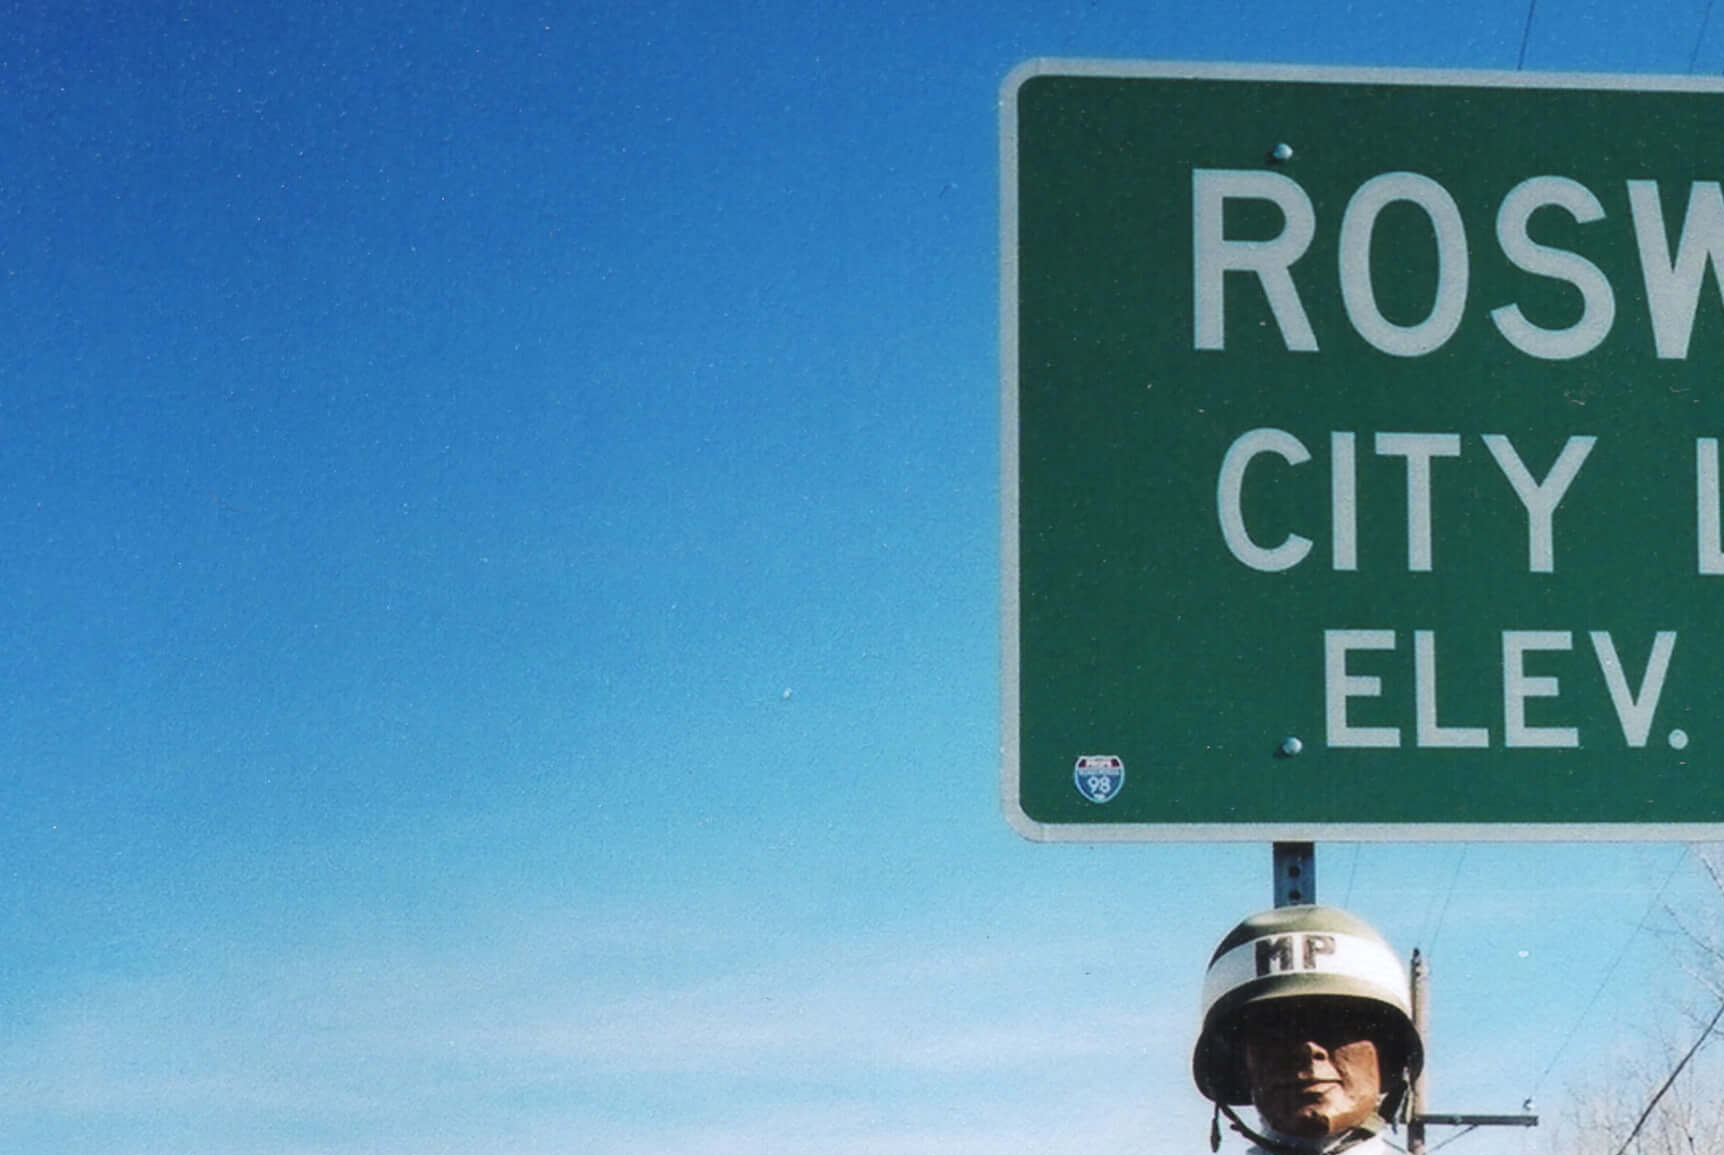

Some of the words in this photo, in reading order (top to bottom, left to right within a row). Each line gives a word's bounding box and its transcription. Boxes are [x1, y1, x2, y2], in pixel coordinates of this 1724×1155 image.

[1217, 428, 1597, 573] CITY
[1324, 629, 1689, 750] ELEV.
[1087, 775, 1111, 794] 98
[1254, 934, 1337, 977] MP
